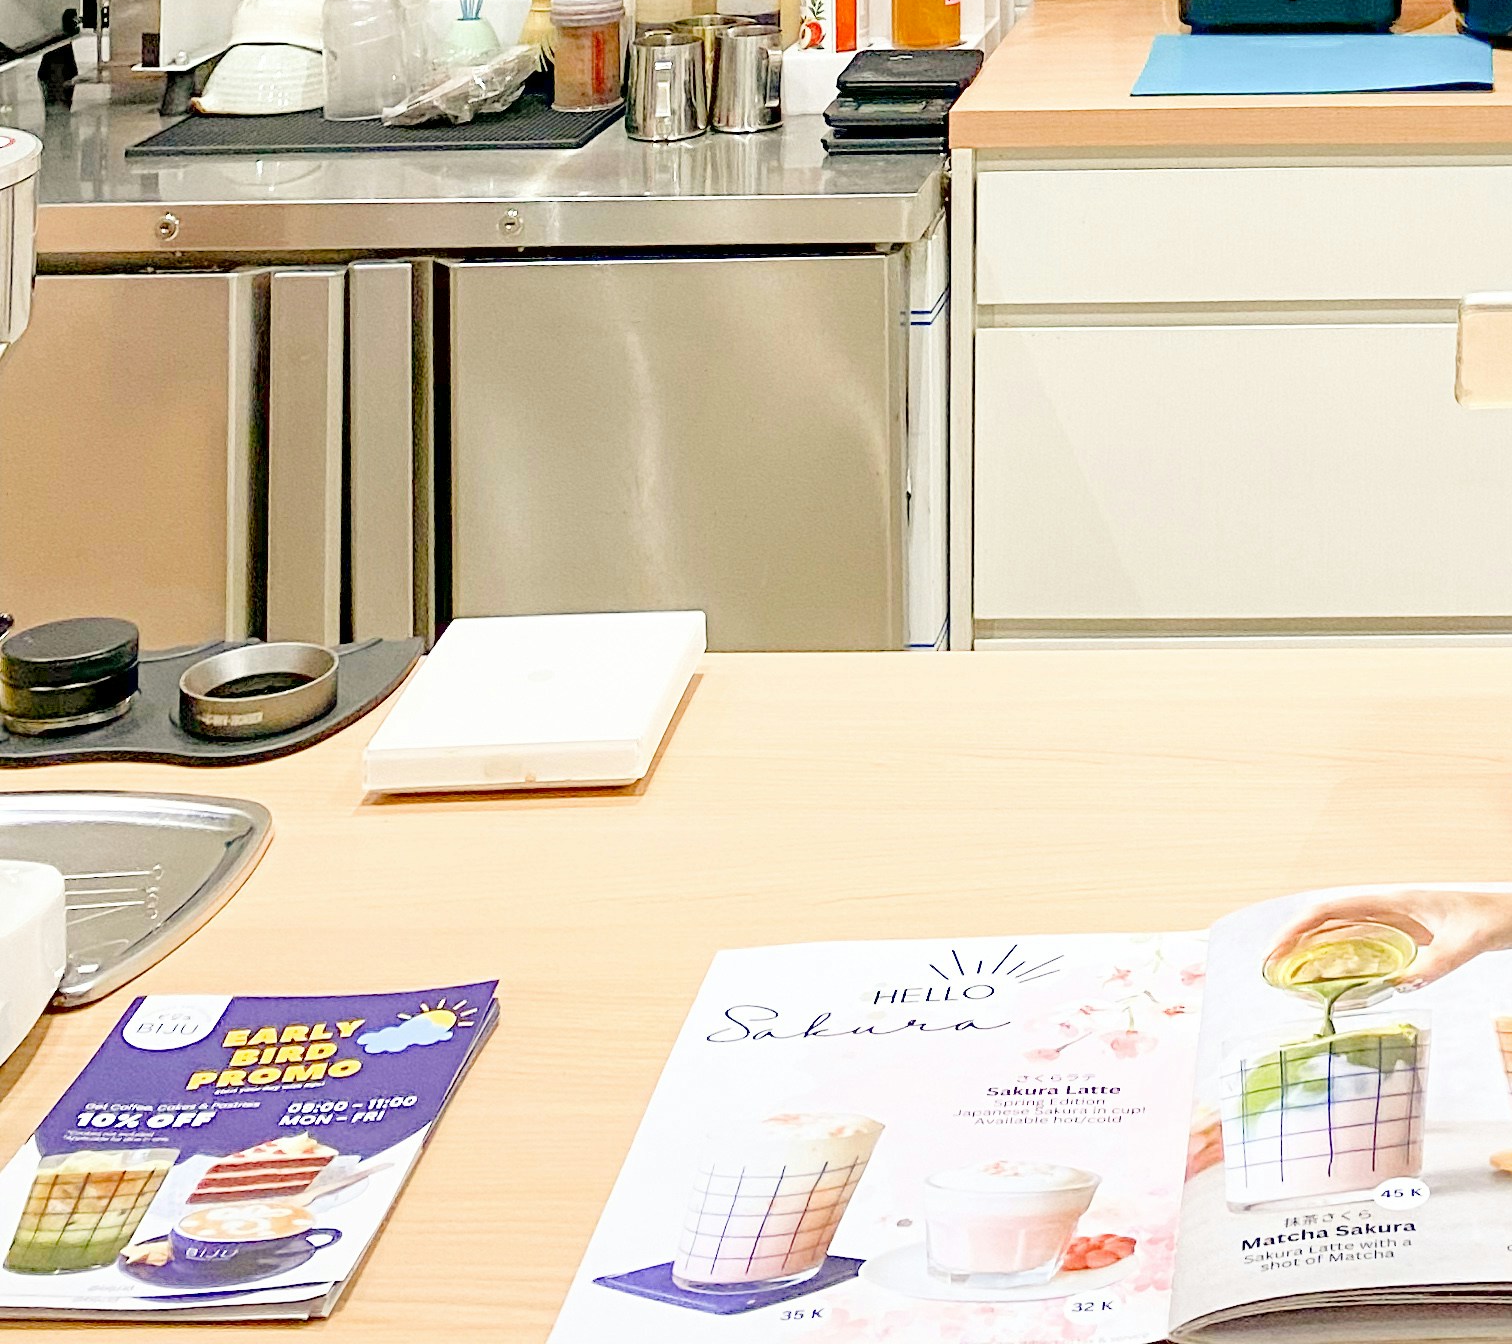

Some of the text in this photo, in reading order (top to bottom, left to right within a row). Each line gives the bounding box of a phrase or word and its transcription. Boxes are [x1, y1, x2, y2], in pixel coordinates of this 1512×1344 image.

[873, 984, 995, 1005] HELLO
[136, 1023, 199, 1035] BIJU
[706, 1004, 1012, 1043] Sakura
[222, 1018, 366, 1048] EARLY
[229, 1041, 338, 1067] BIRD
[185, 1059, 363, 1091] PROMO
[986, 1085, 1122, 1097] Sakura Latte
[198, 1102, 209, 1110] &
[211, 1101, 261, 1111] Pastries
[368, 1095, 418, 1110] 11:00
[994, 1097, 1105, 1109] Spring Edition
[76, 1111, 218, 1129] 10% OFF
[278, 1113, 334, 1127] MON
[350, 1109, 386, 1124] FRI
[953, 1106, 1146, 1118] Japanese Sakura in cup!
[974, 1115, 1122, 1125] Available hot/cold
[1381, 1188, 1423, 1198] 45 K
[1284, 1209, 1372, 1228] 抹茶さくら
[1241, 1222, 1417, 1252] Matcha Sakura
[185, 1247, 239, 1262] BIJU
[1244, 1238, 1412, 1265] Sakura Latte with a
[1260, 1249, 1395, 1272] shot of Matcha
[780, 1308, 825, 1320] 35 K
[1071, 1301, 1113, 1312] 32 K
